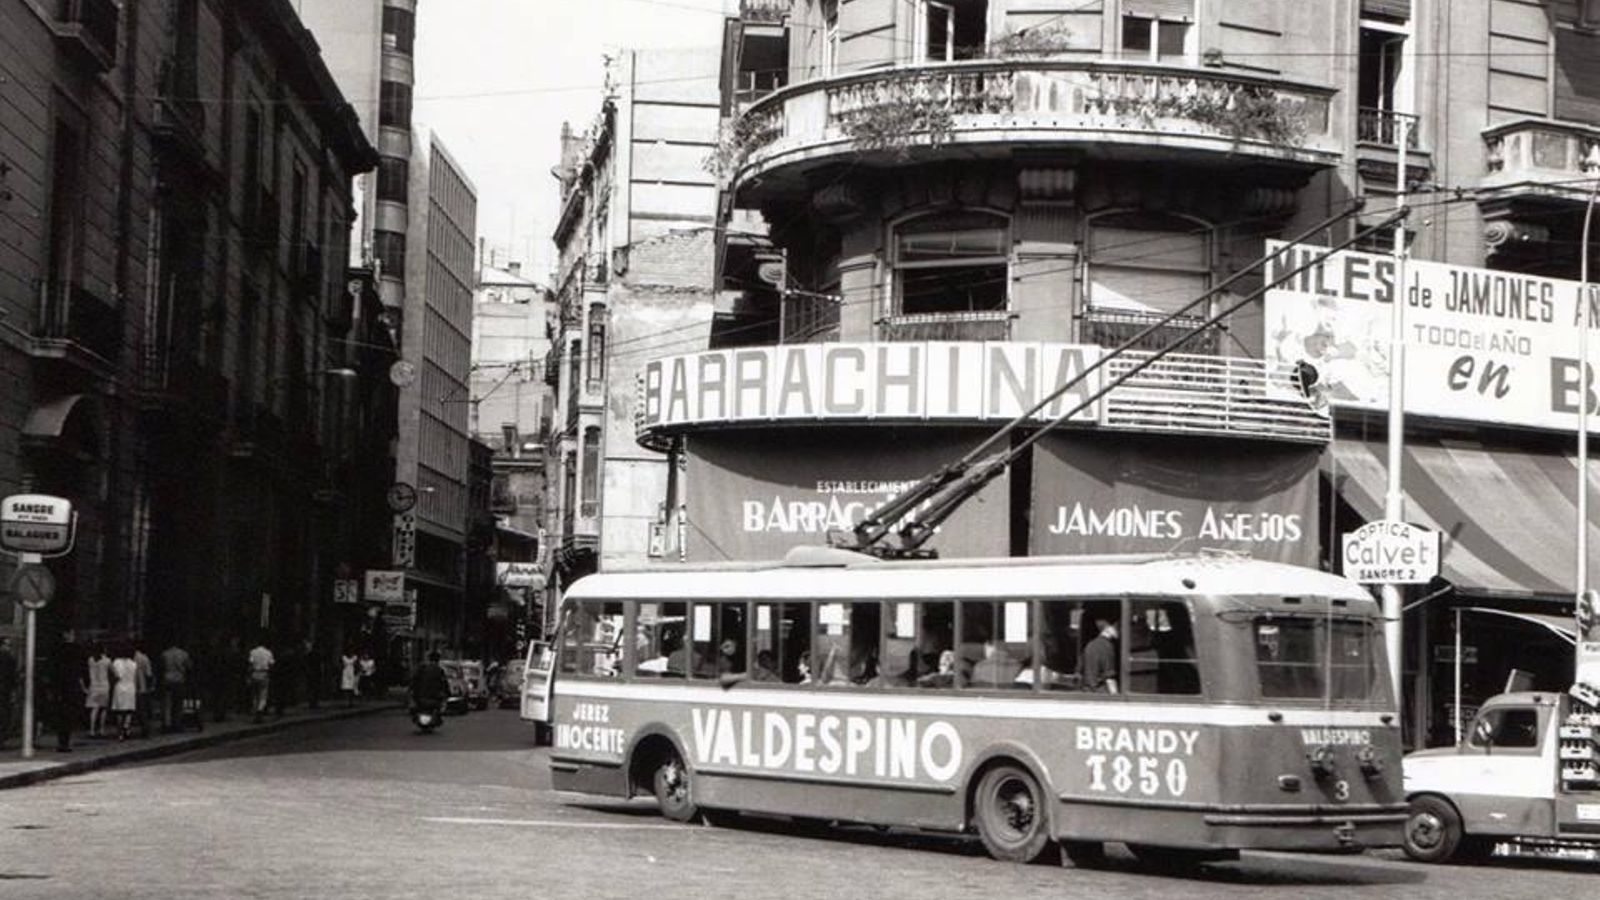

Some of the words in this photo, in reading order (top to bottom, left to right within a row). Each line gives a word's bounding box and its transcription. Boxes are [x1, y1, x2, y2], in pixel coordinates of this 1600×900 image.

[1271, 246, 1395, 303] MILES
[1408, 270, 1432, 309] de
[1445, 269, 1553, 323] JAMONES
[1413, 323, 1471, 349] TODO
[1489, 329, 1532, 356] AÑO
[646, 346, 1096, 424] BARRACHINA
[1447, 355, 1511, 399] en
[1550, 355, 1600, 417] B
[12, 503, 54, 515] SANGRE
[1048, 502, 1183, 539] JAMONES
[1359, 522, 1410, 541] OPTICA
[1346, 540, 1430, 565] Calvet
[1360, 569, 1403, 580] SANGRE
[1409, 569, 1416, 580] 2
[572, 703, 610, 721] JEREZ
[556, 724, 625, 755] INOCENTE
[692, 707, 963, 783] VALDESPINO
[1075, 726, 1200, 755] BRANDY
[1086, 754, 1189, 796] 1850
[1335, 780, 1349, 800] 3
